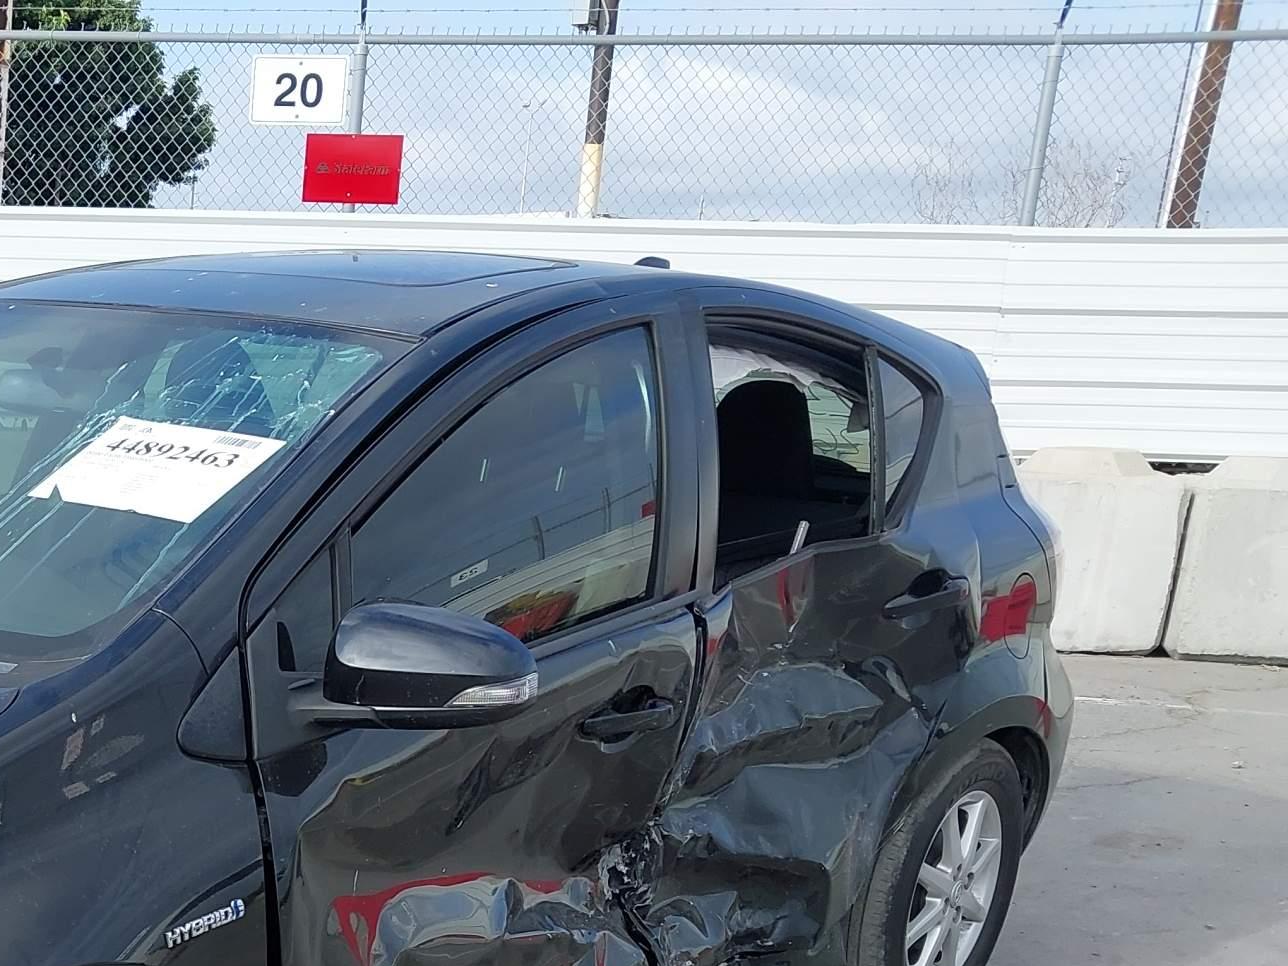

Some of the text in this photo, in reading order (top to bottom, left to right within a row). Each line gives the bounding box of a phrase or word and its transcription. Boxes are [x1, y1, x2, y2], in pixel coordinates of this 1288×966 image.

[273, 72, 324, 108] 20
[106, 438, 240, 468] 44892463
[165, 906, 236, 948] HYBRID
